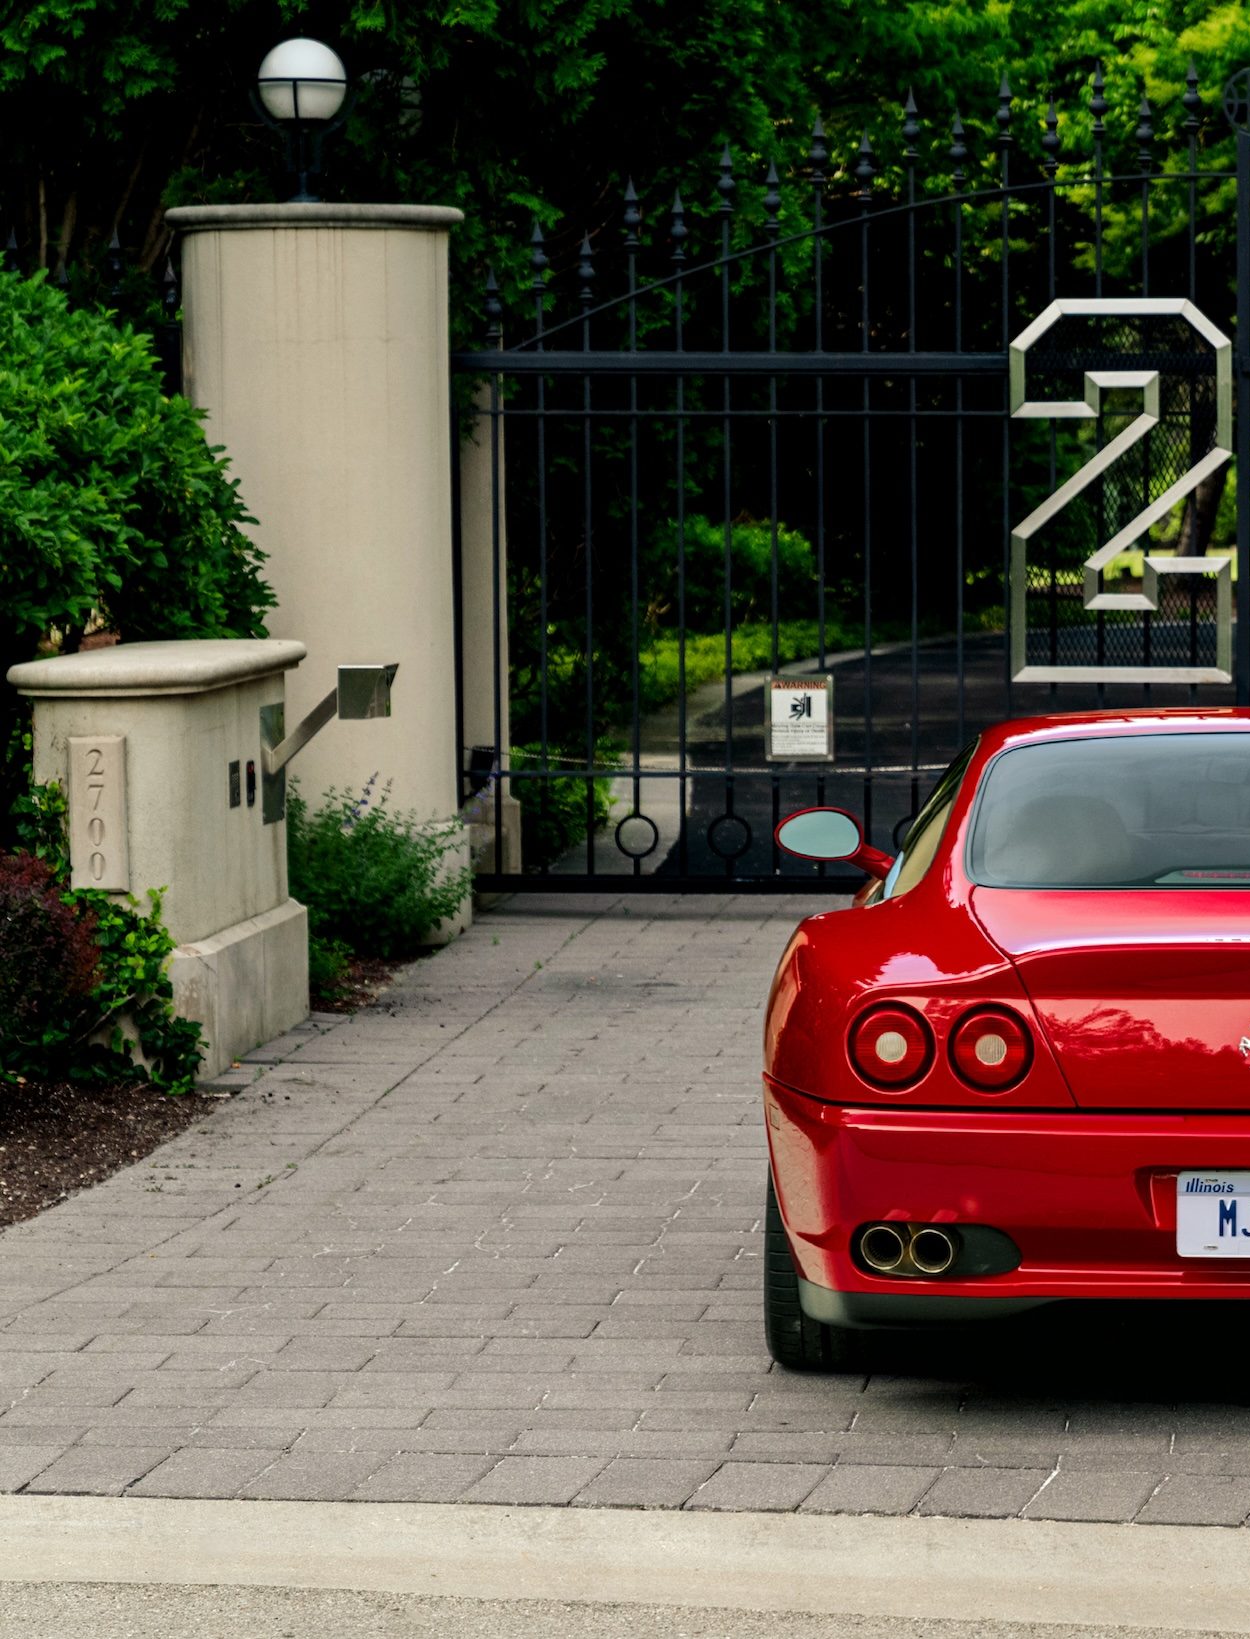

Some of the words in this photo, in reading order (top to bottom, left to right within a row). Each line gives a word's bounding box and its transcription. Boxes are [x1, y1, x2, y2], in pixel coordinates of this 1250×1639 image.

[782, 680, 827, 689] WARNING
[85, 748, 106, 881] 2700
[1185, 1178, 1234, 1193] Illinois
